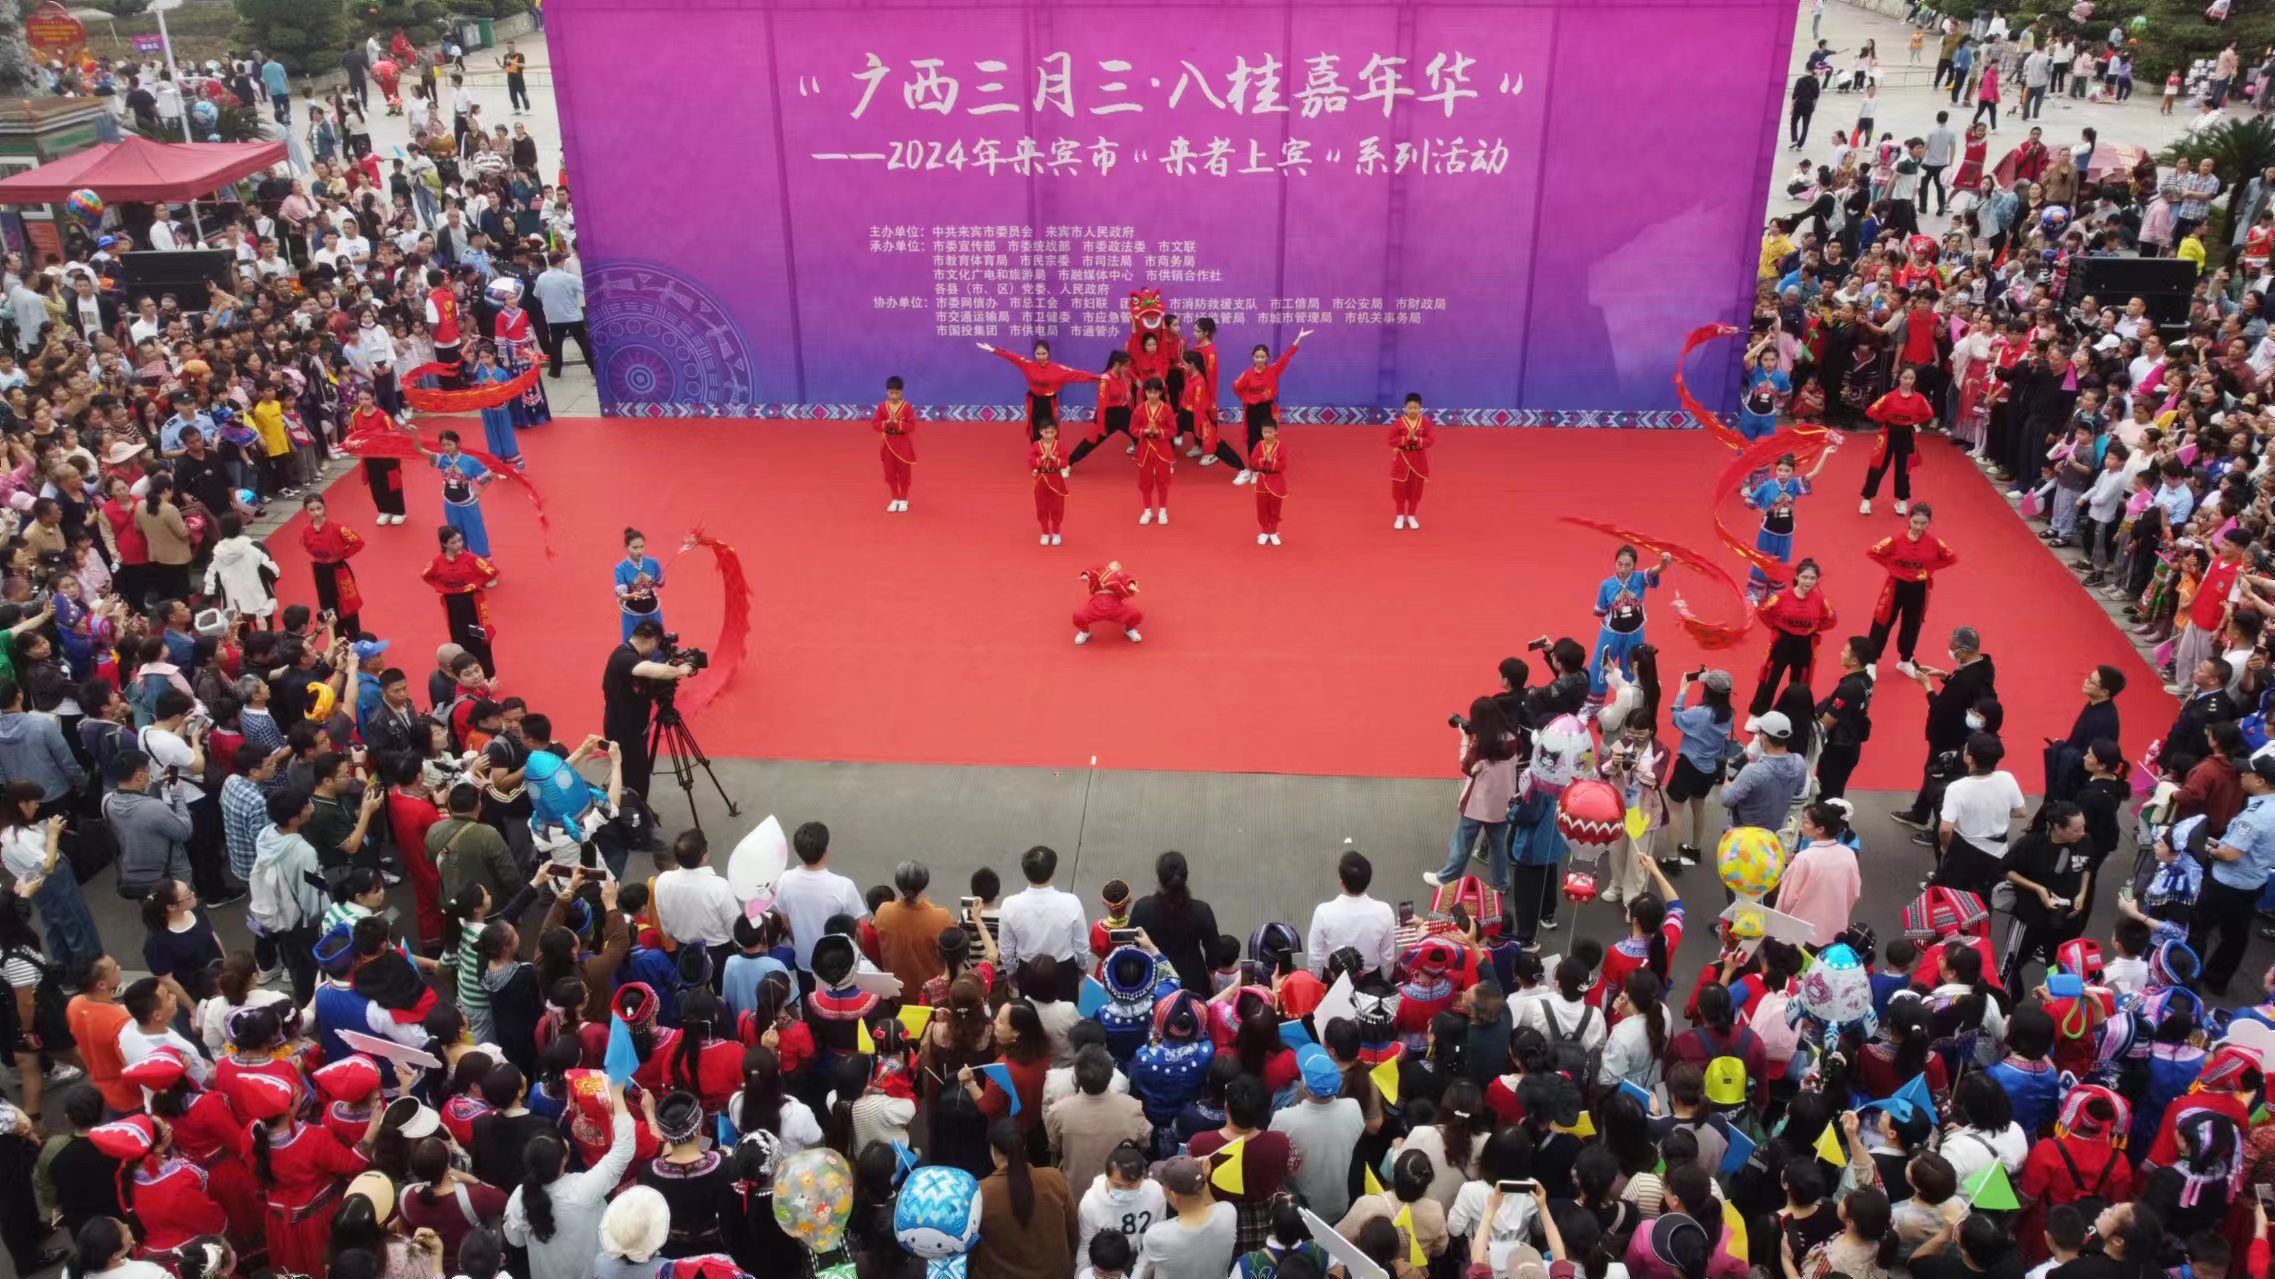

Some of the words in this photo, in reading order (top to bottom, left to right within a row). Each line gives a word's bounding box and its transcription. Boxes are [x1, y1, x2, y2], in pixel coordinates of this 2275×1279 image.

[932, 225, 1033, 238] 中共来宾市委员会
[1045, 225, 1135, 239] 来宾市人民政府
[932, 240, 996, 252] 市委宣传部
[1082, 240, 1146, 253] 市委政法委
[1157, 240, 1197, 253] 市文联
[932, 254, 1008, 266] 市教育体育局
[1019, 254, 1070, 267] 市民宗委
[1082, 254, 1133, 268] 市司法局
[1144, 254, 1196, 268] 市商务局
[933, 268, 1046, 281] 市文化广电和旅游局
[1057, 268, 1134, 282] 市融媒体中心
[1145, 268, 1222, 282] 市供销合作社
[1009, 296, 1058, 309] 市总工会
[1071, 296, 1109, 310] 市妇联
[1169, 297, 1258, 310] 市消防救援支队
[1270, 297, 1320, 310] 市工信局
[1332, 297, 1383, 310] 市公安局
[1395, 297, 1447, 311] 市财政局
[935, 310, 1010, 323] 市交通运输局
[1021, 310, 1071, 323] 市卫健委
[1257, 311, 1333, 324] 市城市管理局
[1344, 311, 1422, 325] 市机关事务局
[935, 324, 998, 337] 市国投集团
[1009, 324, 1059, 337] 市供电局
[1121, 1209, 1151, 1235] 82
